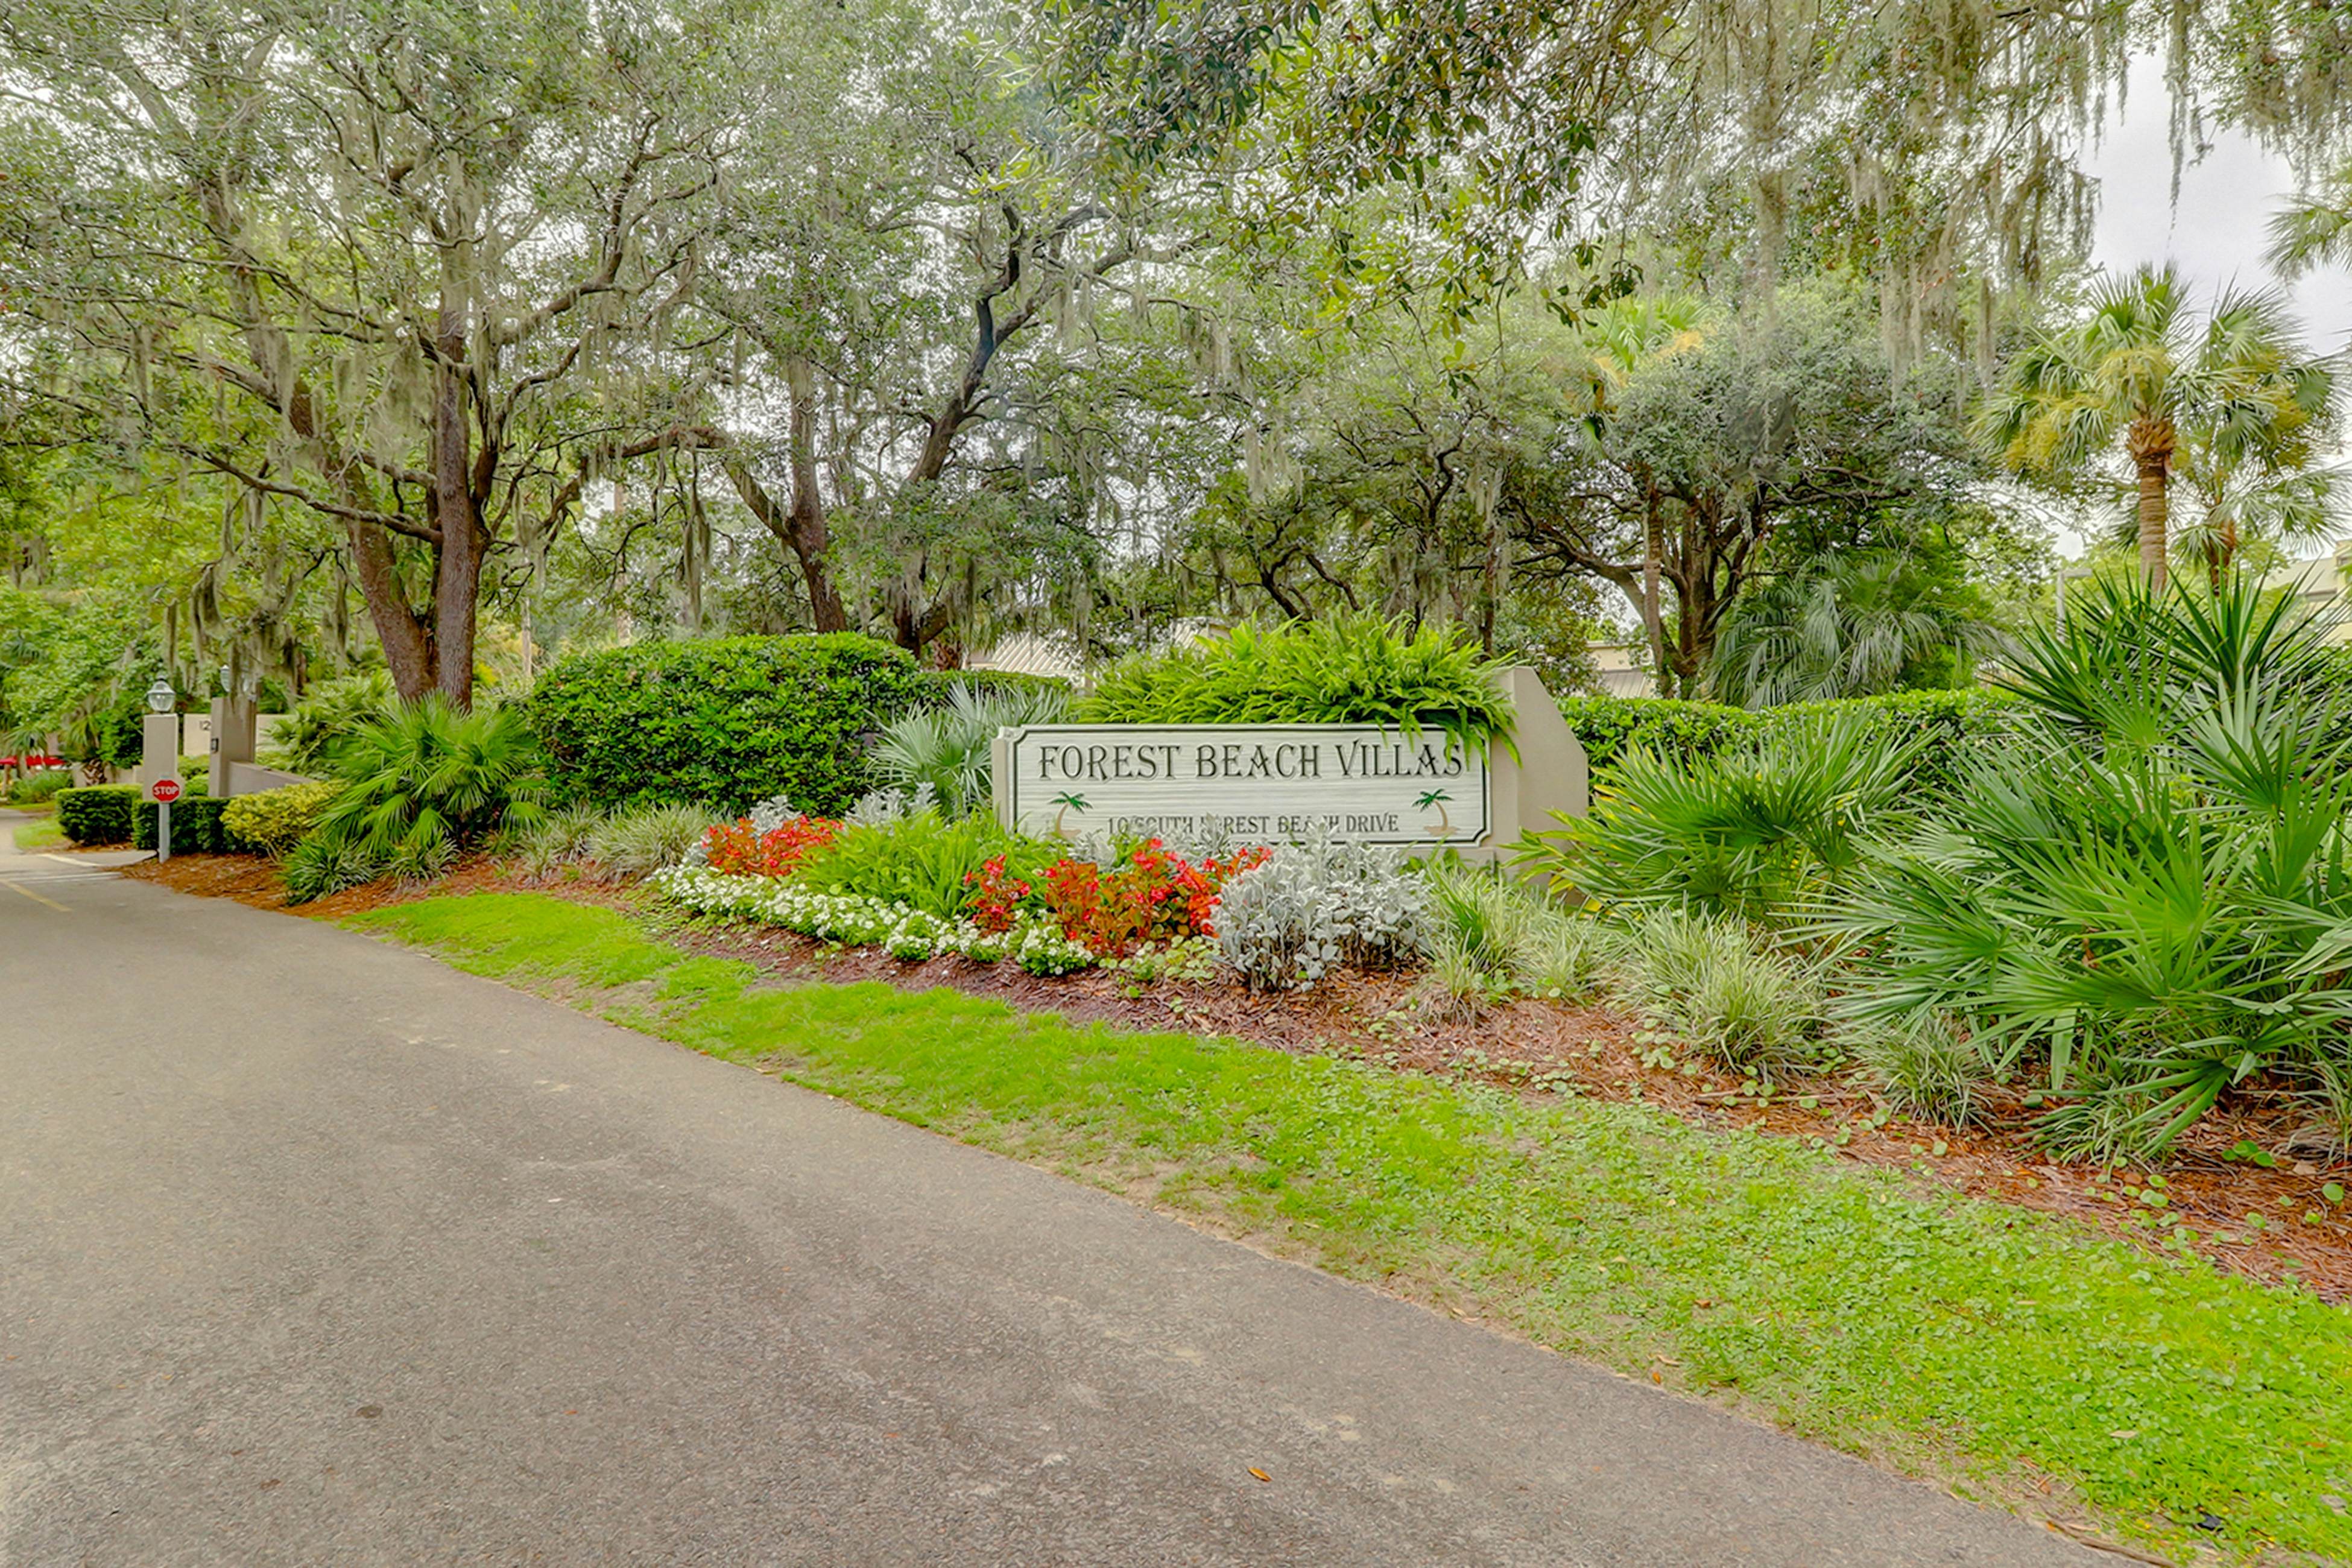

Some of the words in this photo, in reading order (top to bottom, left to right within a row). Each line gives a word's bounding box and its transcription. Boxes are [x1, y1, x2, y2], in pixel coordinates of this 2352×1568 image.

[1039, 744, 1181, 781] FOREST
[1195, 744, 1321, 779] BEACH
[1334, 738, 1462, 777] VILLAS
[154, 786, 179, 795] STOP
[1345, 812, 1399, 833] DRIVE
